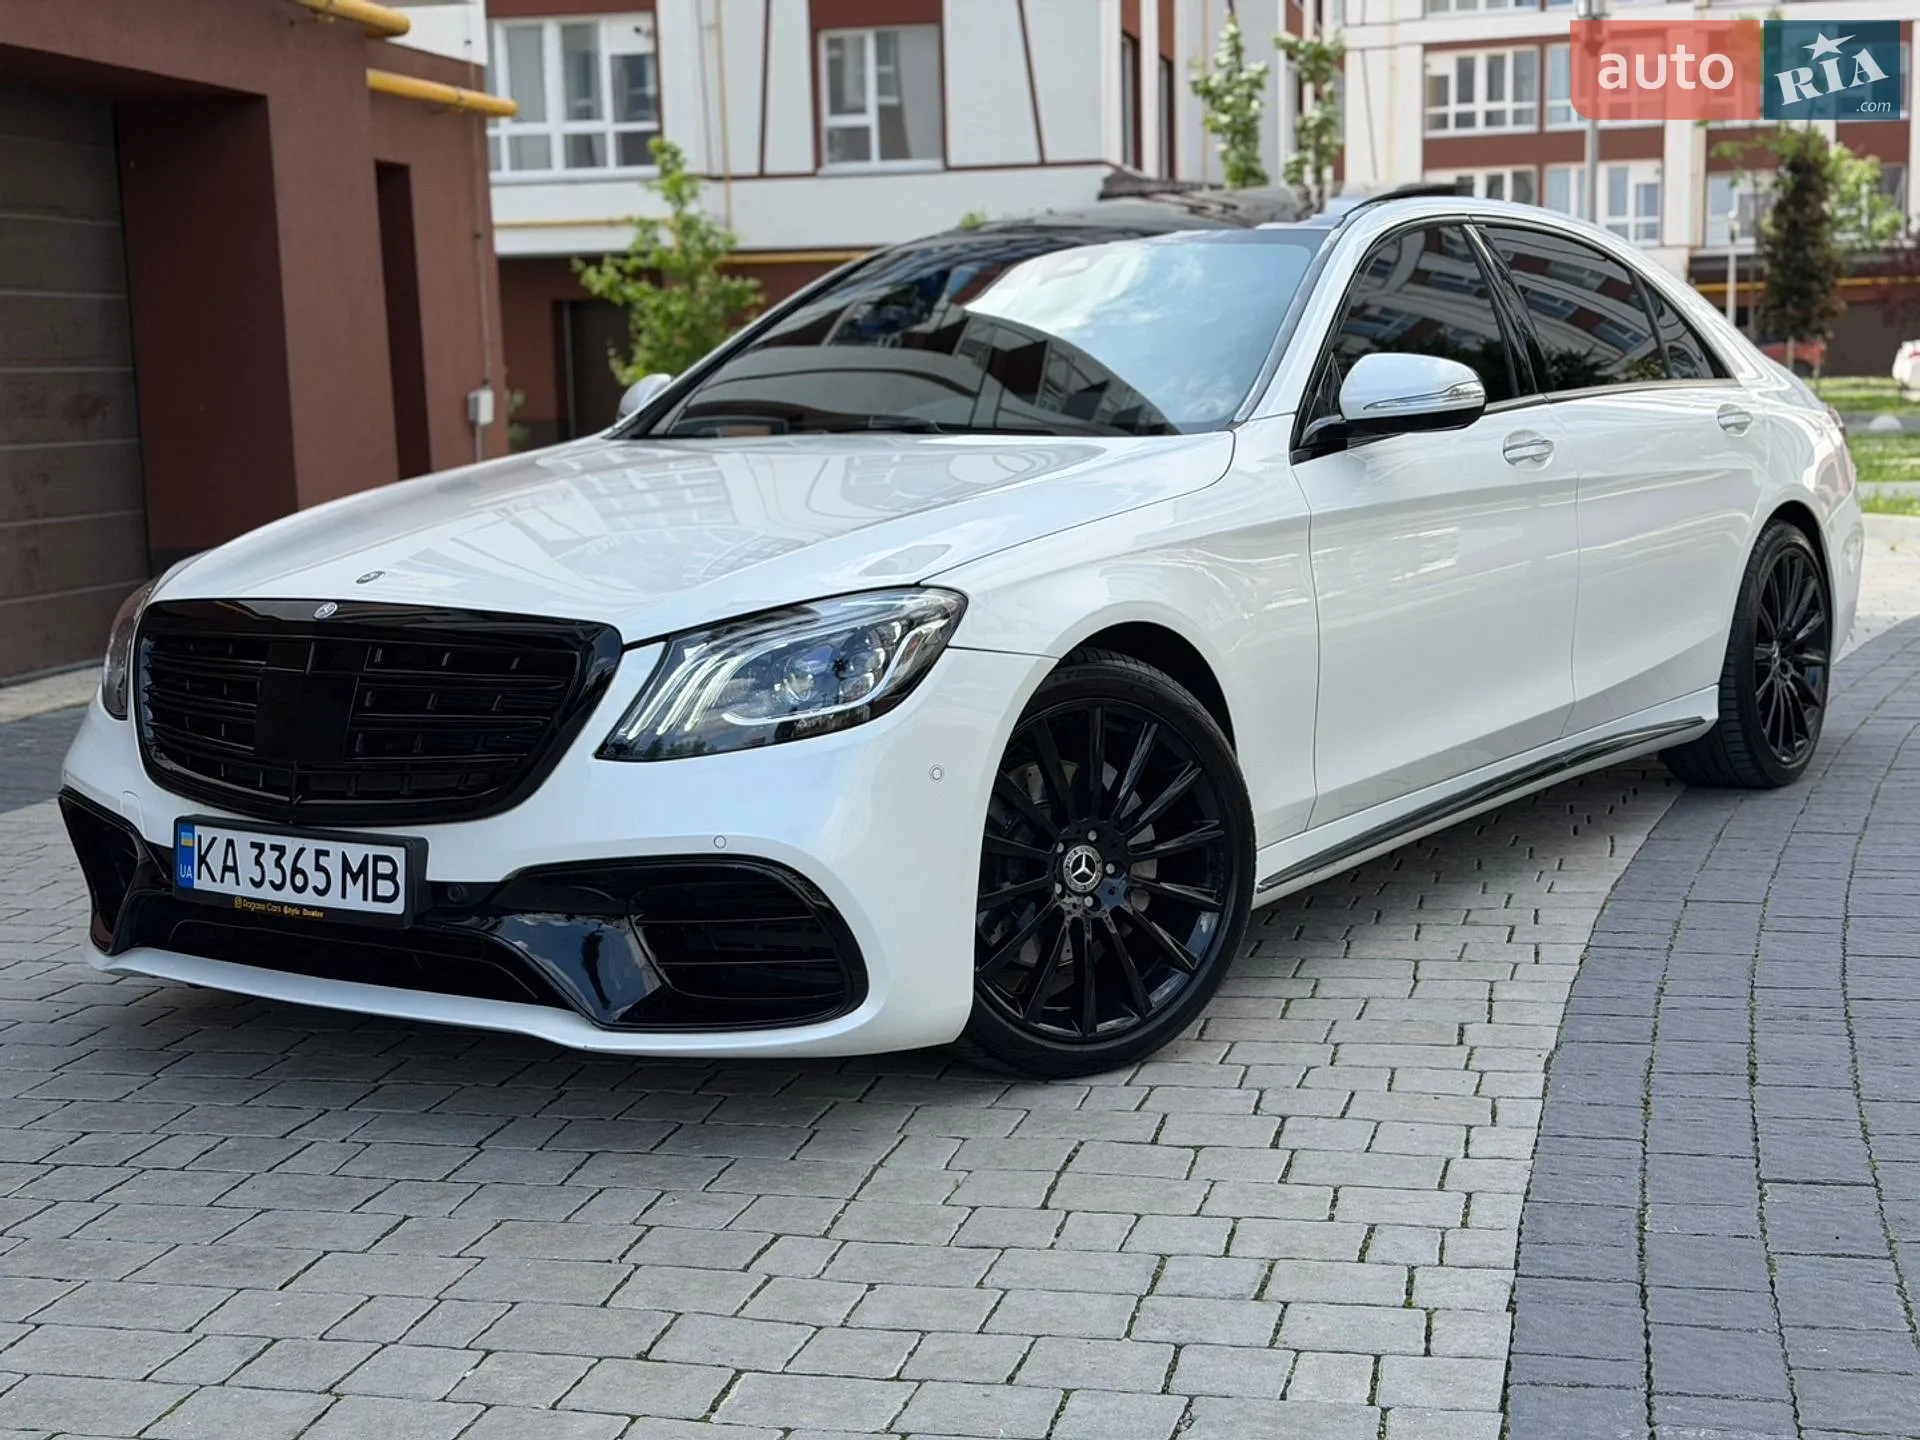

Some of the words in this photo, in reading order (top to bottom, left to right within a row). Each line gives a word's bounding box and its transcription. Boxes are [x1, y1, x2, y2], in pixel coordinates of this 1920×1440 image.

[179, 863, 193, 880] UA
[197, 834, 240, 886] KA
[248, 840, 332, 897] 3365
[340, 850, 400, 904] MB
